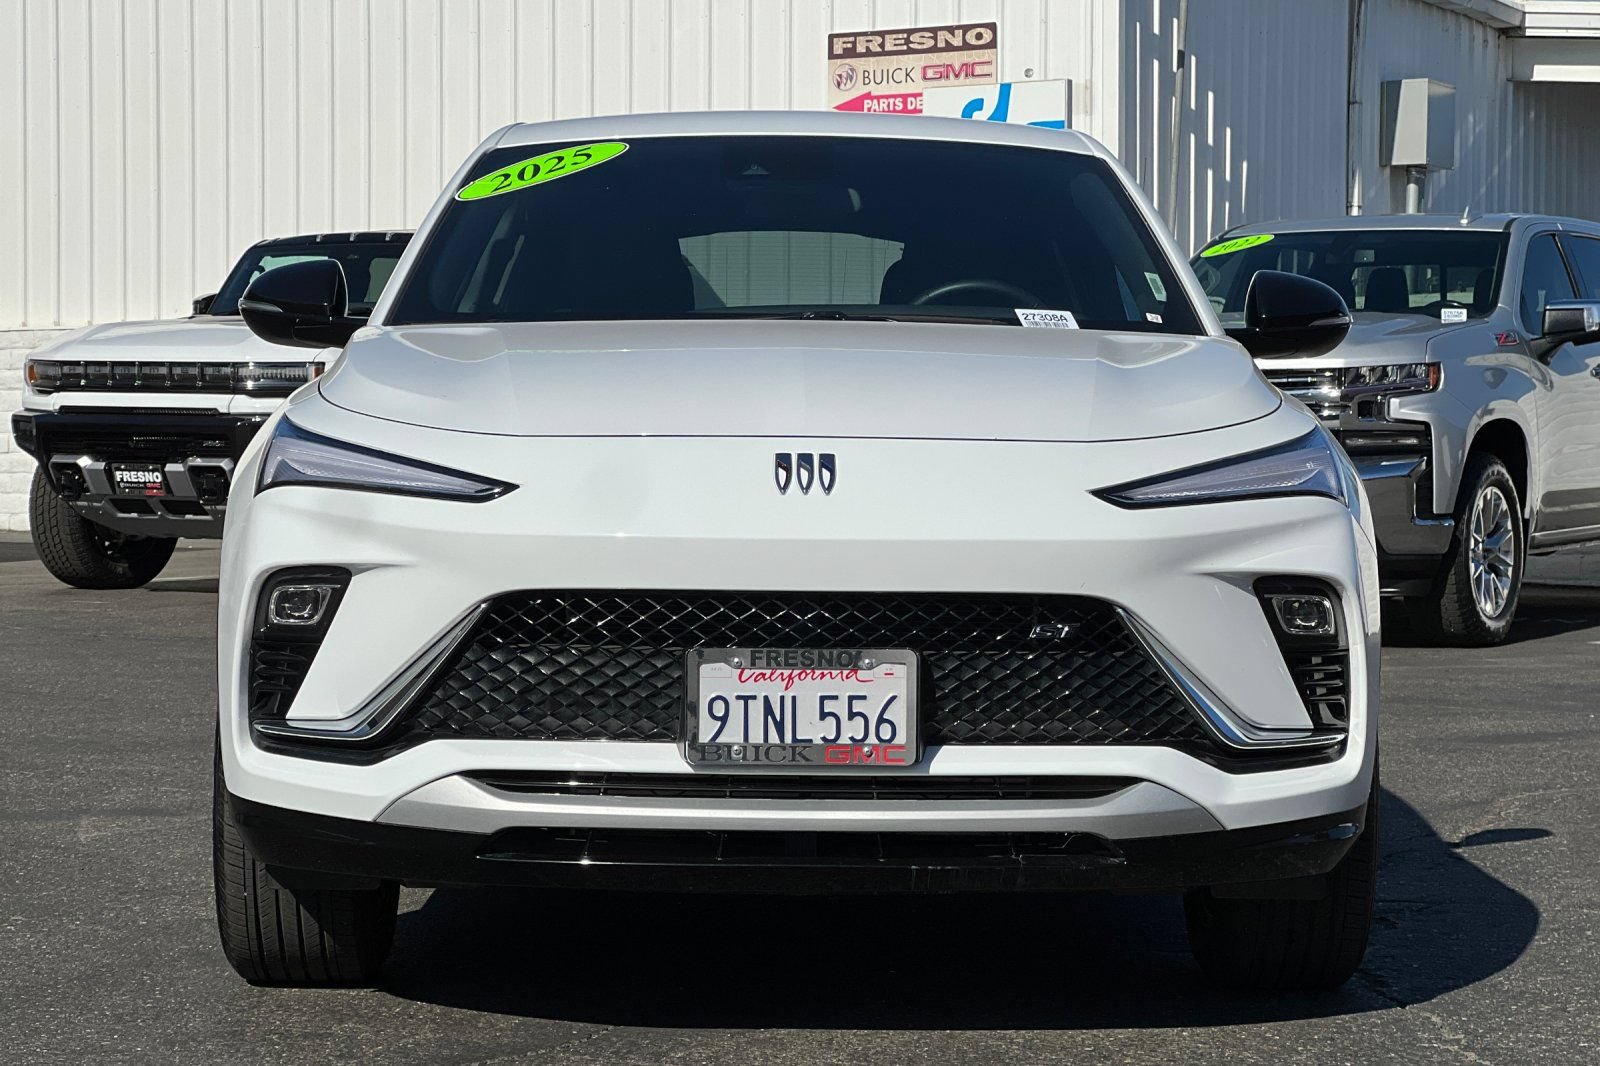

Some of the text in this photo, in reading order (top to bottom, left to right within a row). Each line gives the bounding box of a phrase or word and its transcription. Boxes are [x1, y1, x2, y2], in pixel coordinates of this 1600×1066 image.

[832, 27, 994, 54] FRESNO
[861, 60, 993, 86] BUICK GMC
[863, 97, 903, 112] PARTS
[490, 146, 593, 193] 2025
[1021, 312, 1069, 322] 27308A
[115, 471, 162, 482] FRESNO
[750, 649, 855, 667] FRESNO
[738, 668, 874, 691] California
[707, 695, 898, 744] 9TNL556
[700, 745, 906, 764] BUICK GMC
